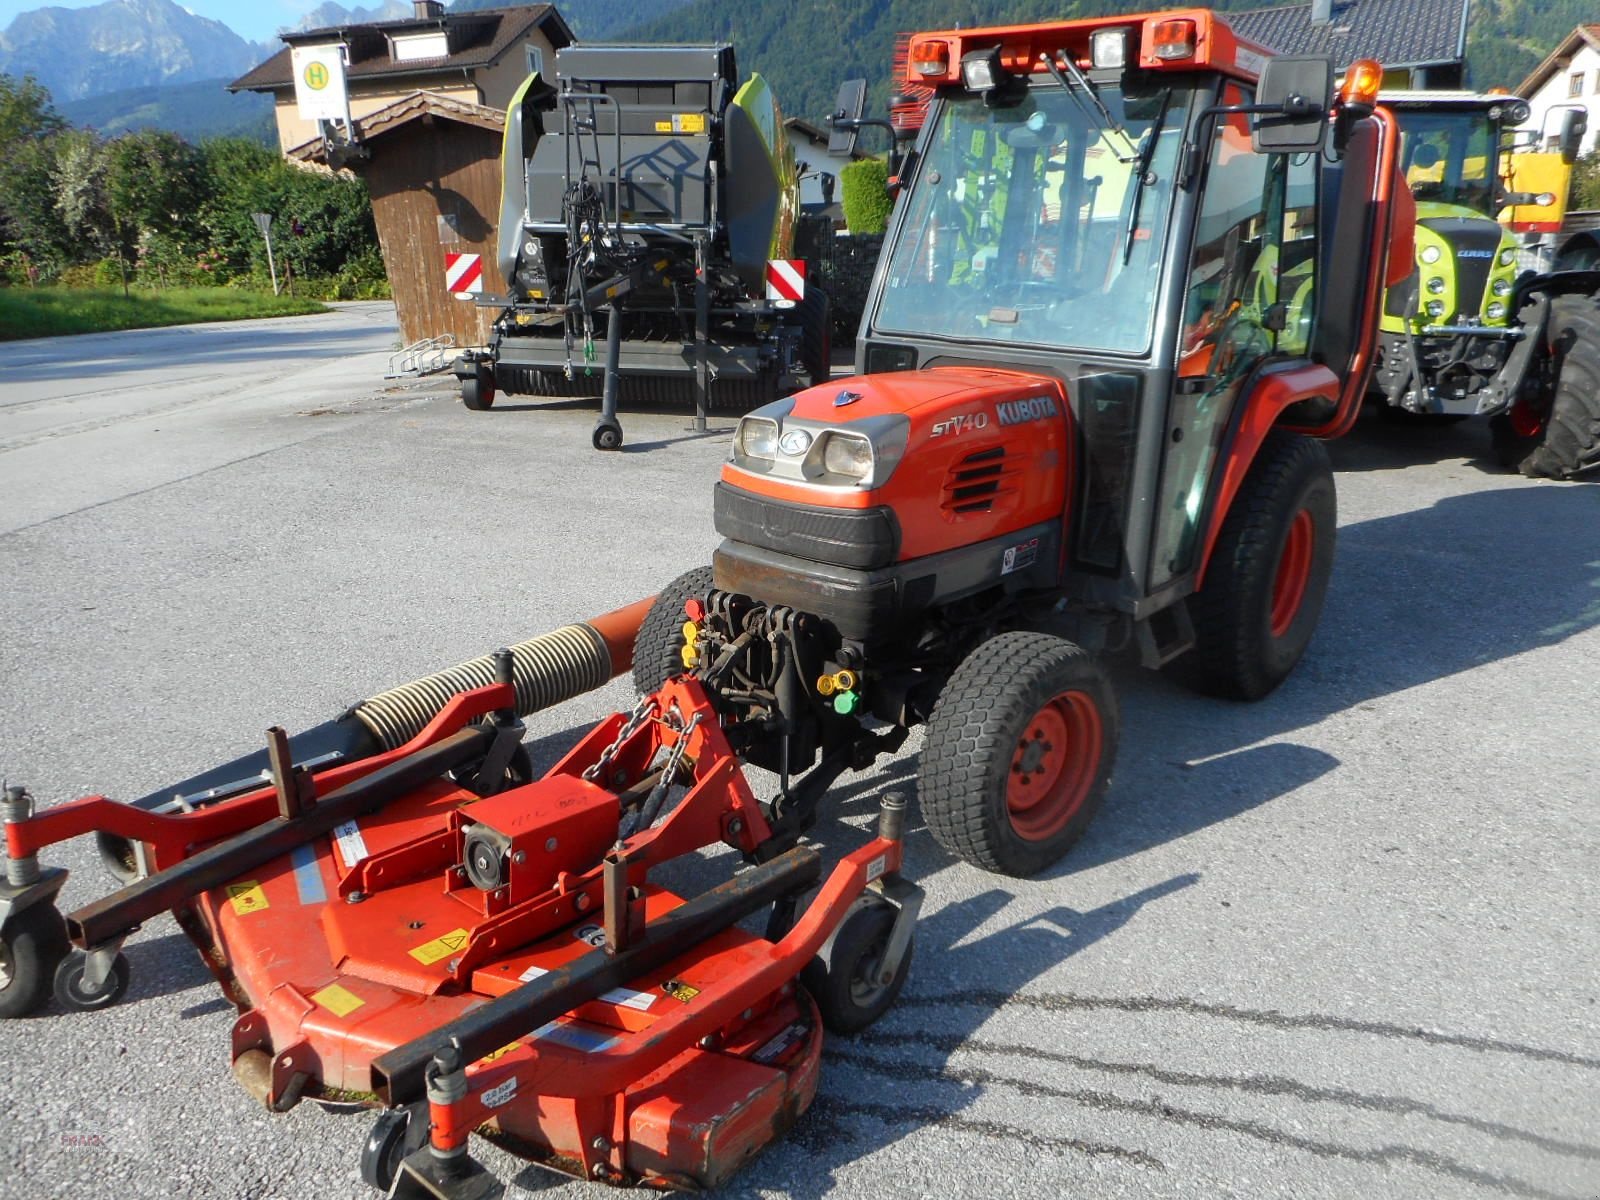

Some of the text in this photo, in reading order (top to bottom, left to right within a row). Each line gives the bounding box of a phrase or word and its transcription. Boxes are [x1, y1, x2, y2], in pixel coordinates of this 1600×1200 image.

[309, 66, 323, 85] H
[1457, 249, 1493, 258] CLAAS
[994, 396, 1058, 426] KUBOTA
[930, 412, 988, 438] STV40
